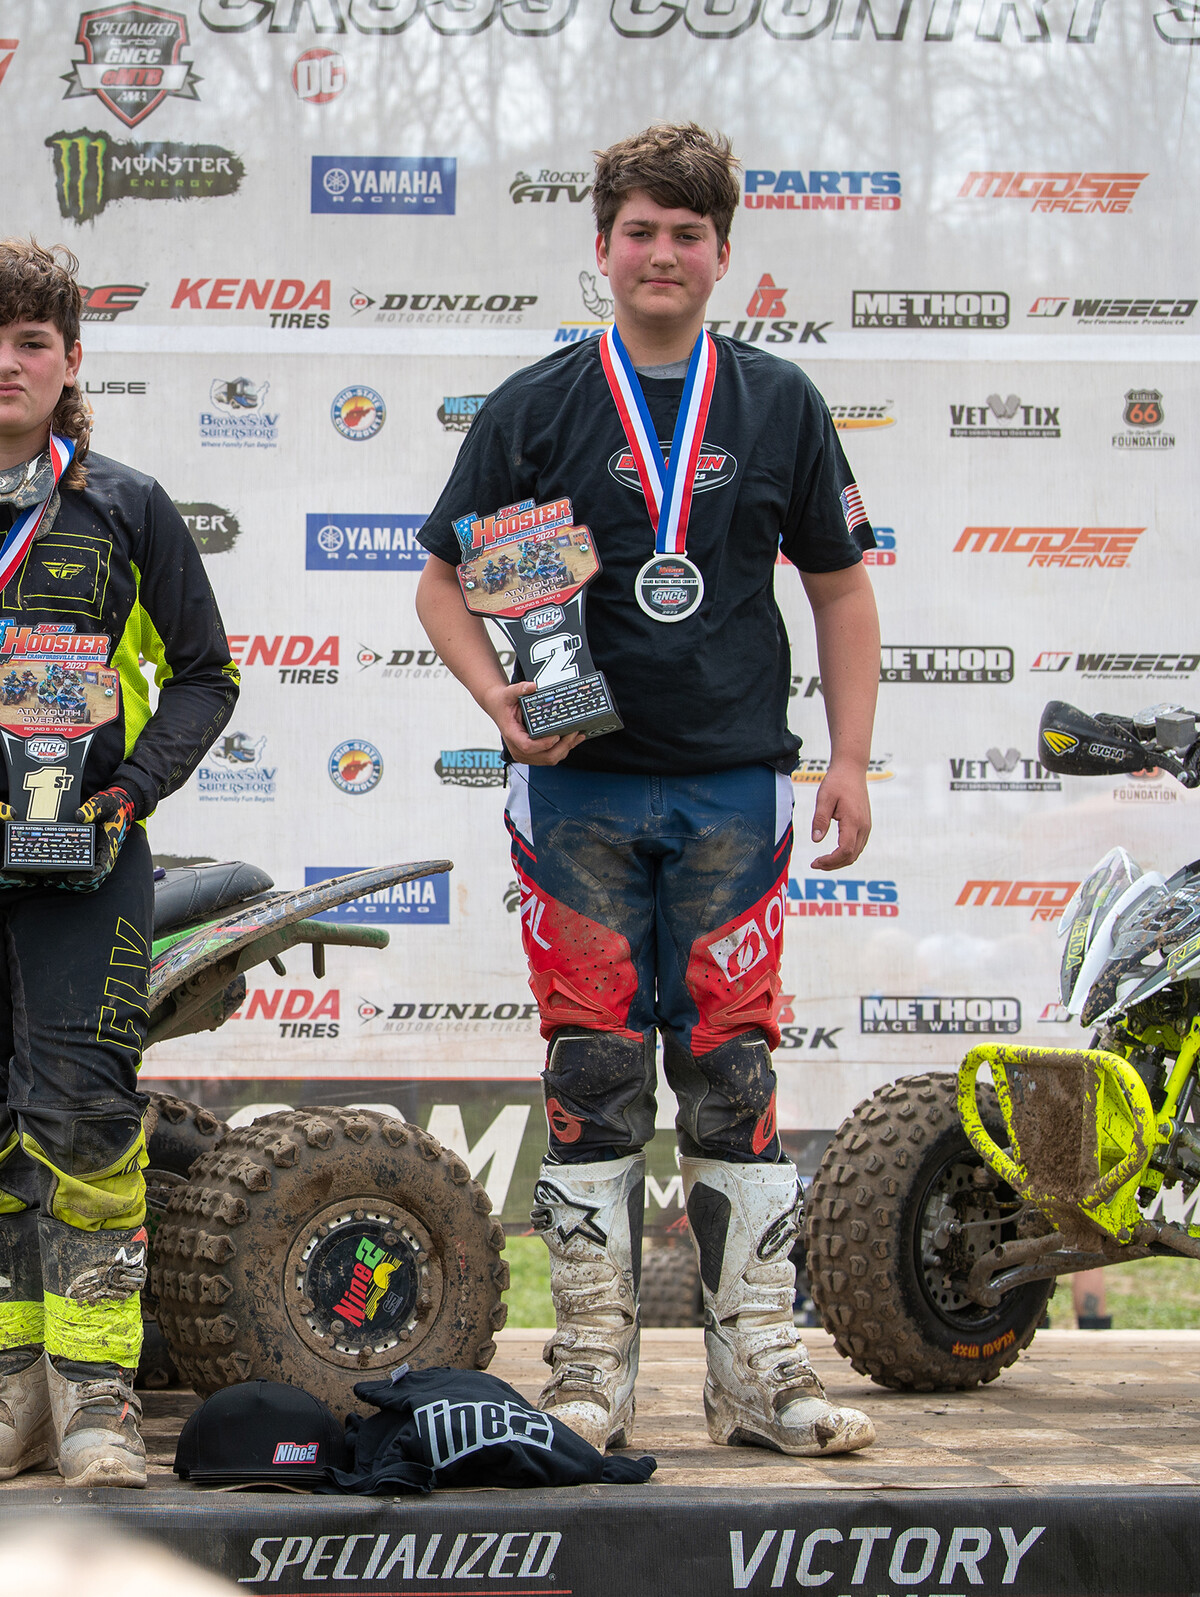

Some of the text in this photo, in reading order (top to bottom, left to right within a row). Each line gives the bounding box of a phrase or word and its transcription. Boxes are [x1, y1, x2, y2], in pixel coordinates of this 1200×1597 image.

[89, 21, 176, 36] SPECIALIZED
[104, 48, 161, 64] GNCC
[297, 54, 345, 99] DC
[111, 153, 233, 176] MONSTER
[129, 178, 215, 188] ENERGY
[350, 170, 443, 194] YAMAHA
[537, 169, 591, 184] ROCKY
[744, 170, 901, 194] PARTS
[956, 172, 1151, 199] MOOSE
[332, 195, 436, 203] RACING
[744, 195, 901, 211] UNLIMITED
[1030, 200, 1132, 214] RACING
[170, 278, 331, 310] KENDA
[379, 294, 538, 312] DUNLOP
[859, 293, 1008, 315] METHOD
[269, 313, 330, 328] TIRES
[374, 312, 524, 323] MOTORCYCLE TIRES
[855, 315, 1007, 327] RACE WHEELS
[950, 405, 1060, 426] VET TIX
[1129, 403, 1158, 423] 66
[1111, 435, 1176, 448] FOUNDATION
[471, 499, 572, 549] HOOSIER
[535, 531, 557, 543] 2023
[952, 526, 1148, 553] MOOSE
[1027, 554, 1129, 568] RACING
[503, 574, 565, 599] ATV YOUTH
[511, 585, 561, 604] OVERALL
[653, 590, 687, 601] GNCC
[526, 608, 561, 629] GNCC
[35, 624, 75, 634] AMSOIL
[0, 626, 110, 654] HOOSIER
[64, 662, 87, 670] 2023
[278, 669, 339, 684] TIRES
[922, 671, 1011, 681] WHEELS
[16, 708, 81, 717] ATV YOUTH
[22, 717, 75, 725] OVERALL
[29, 742, 66, 753] GNCC
[1088, 742, 1125, 760] CYCRA
[949, 758, 990, 778] VET
[1113, 789, 1178, 801] FOUNDATION
[1065, 914, 1092, 971] KENDA
[387, 1003, 540, 1019] DUNLOP
[863, 998, 1019, 1022] METHOD
[279, 1023, 340, 1038] TIRES
[382, 1021, 487, 1032] MOTORCYCLE
[863, 1021, 1018, 1032] RACE WHEELS
[272, 1441, 320, 1465] Nine2
[237, 1531, 563, 1583] SPECIALIZED
[728, 1526, 1047, 1589] VICTORY
